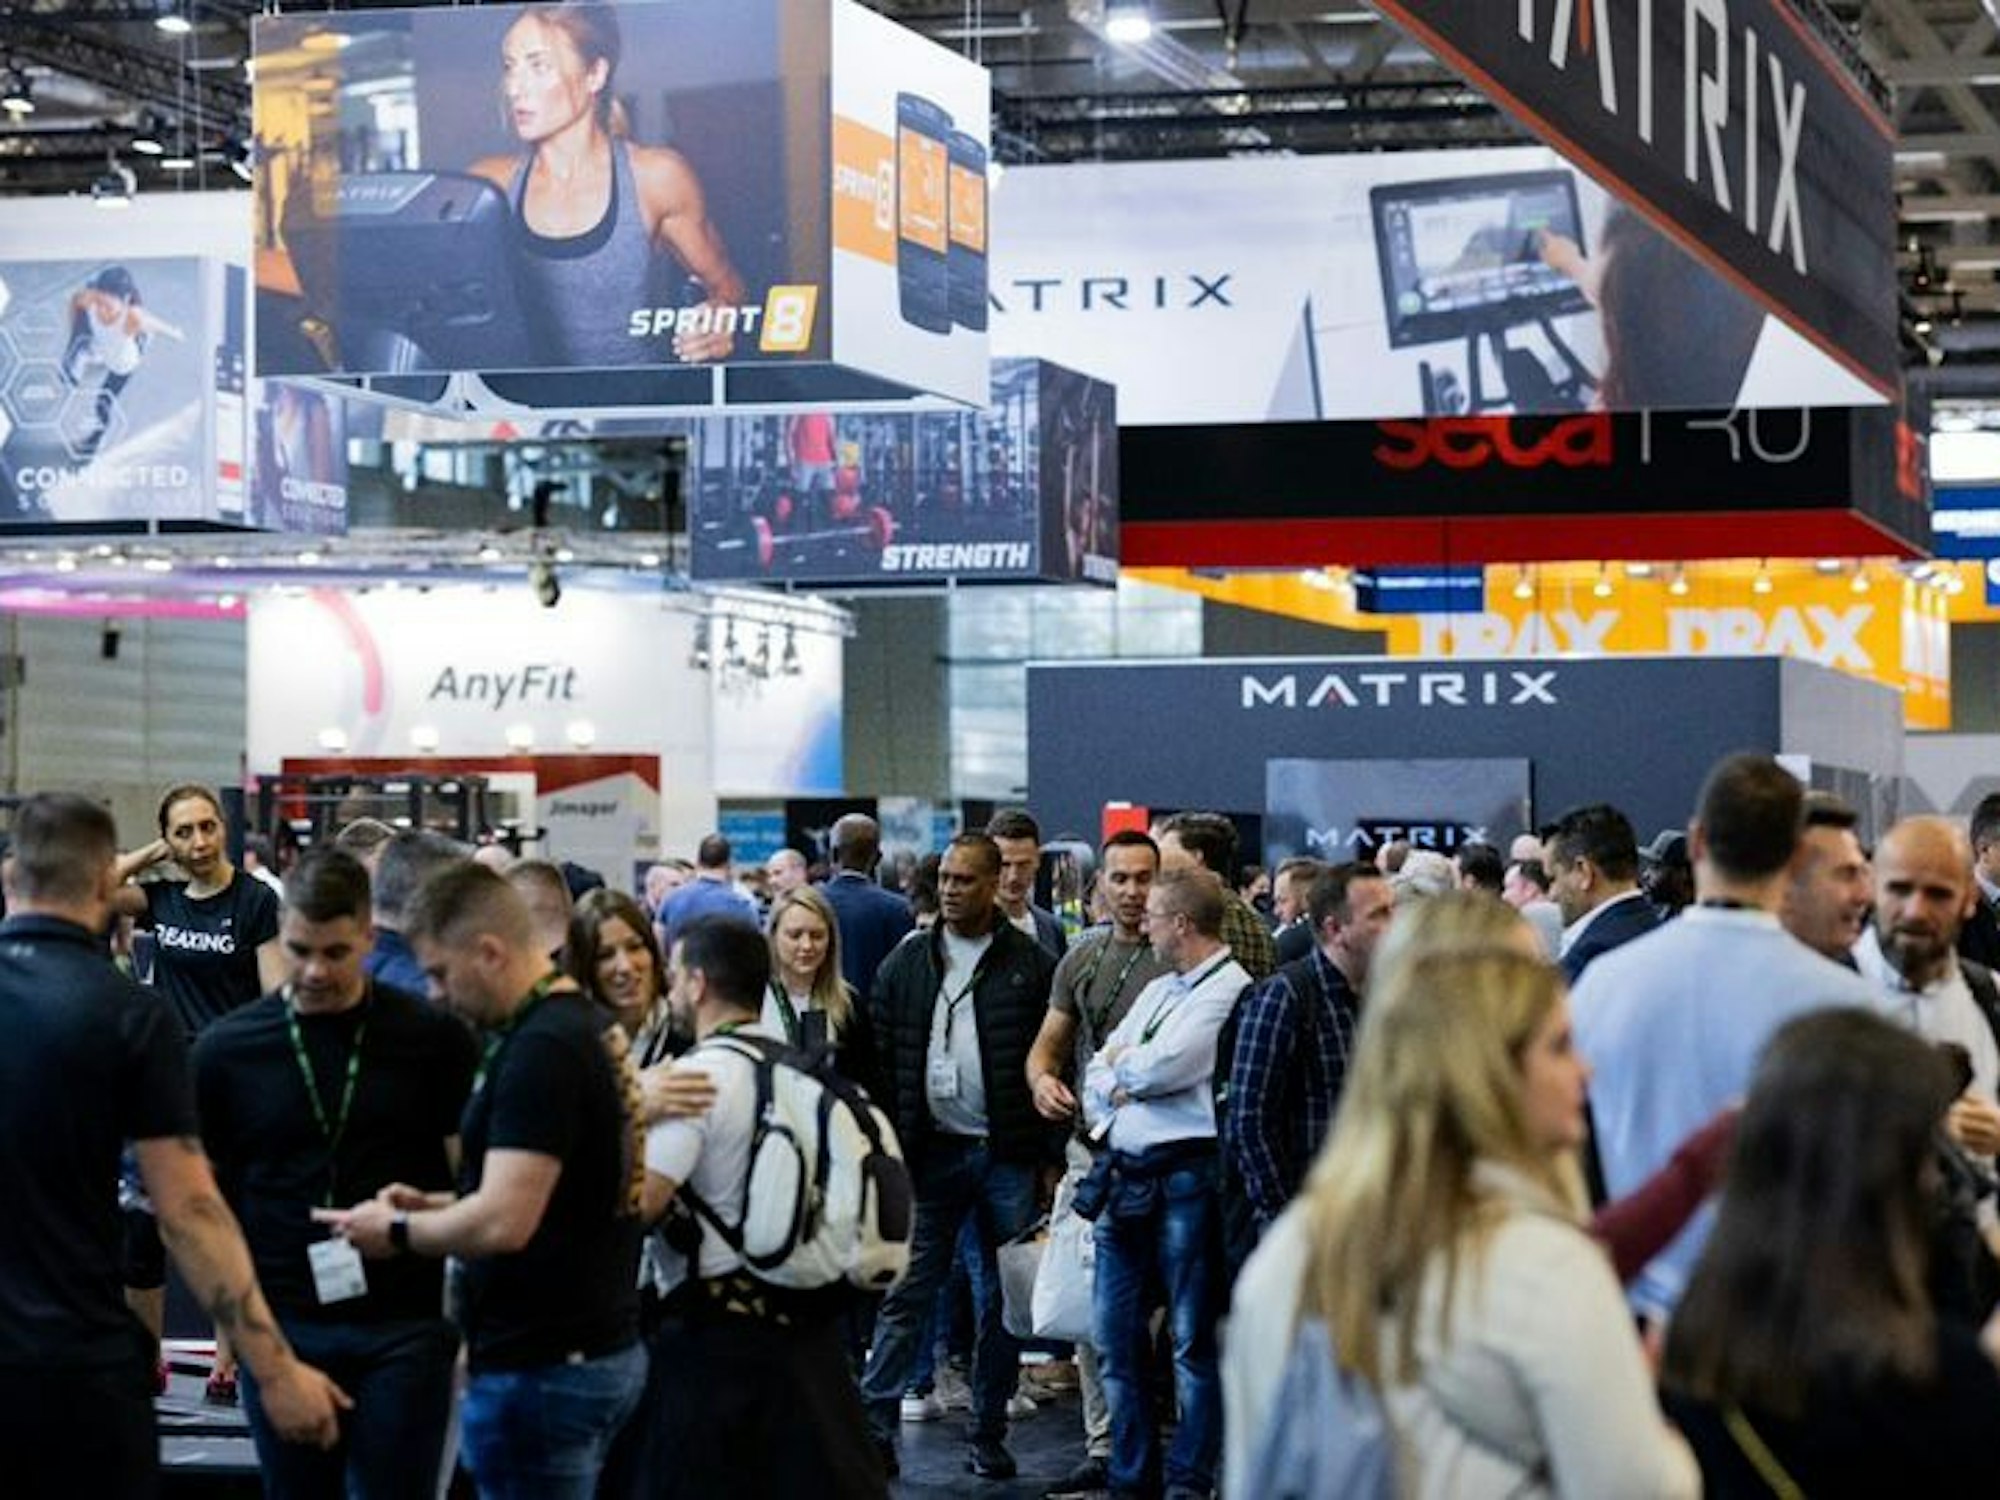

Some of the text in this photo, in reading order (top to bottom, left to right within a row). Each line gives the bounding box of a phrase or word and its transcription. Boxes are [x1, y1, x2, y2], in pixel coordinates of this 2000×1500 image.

[628, 305, 762, 336] SPRINT
[880, 542, 1031, 571] STRENGTH
[428, 665, 577, 712] AnyFit
[1241, 671, 1558, 708] MATRIX
[1305, 825, 1489, 847] MATRIX
